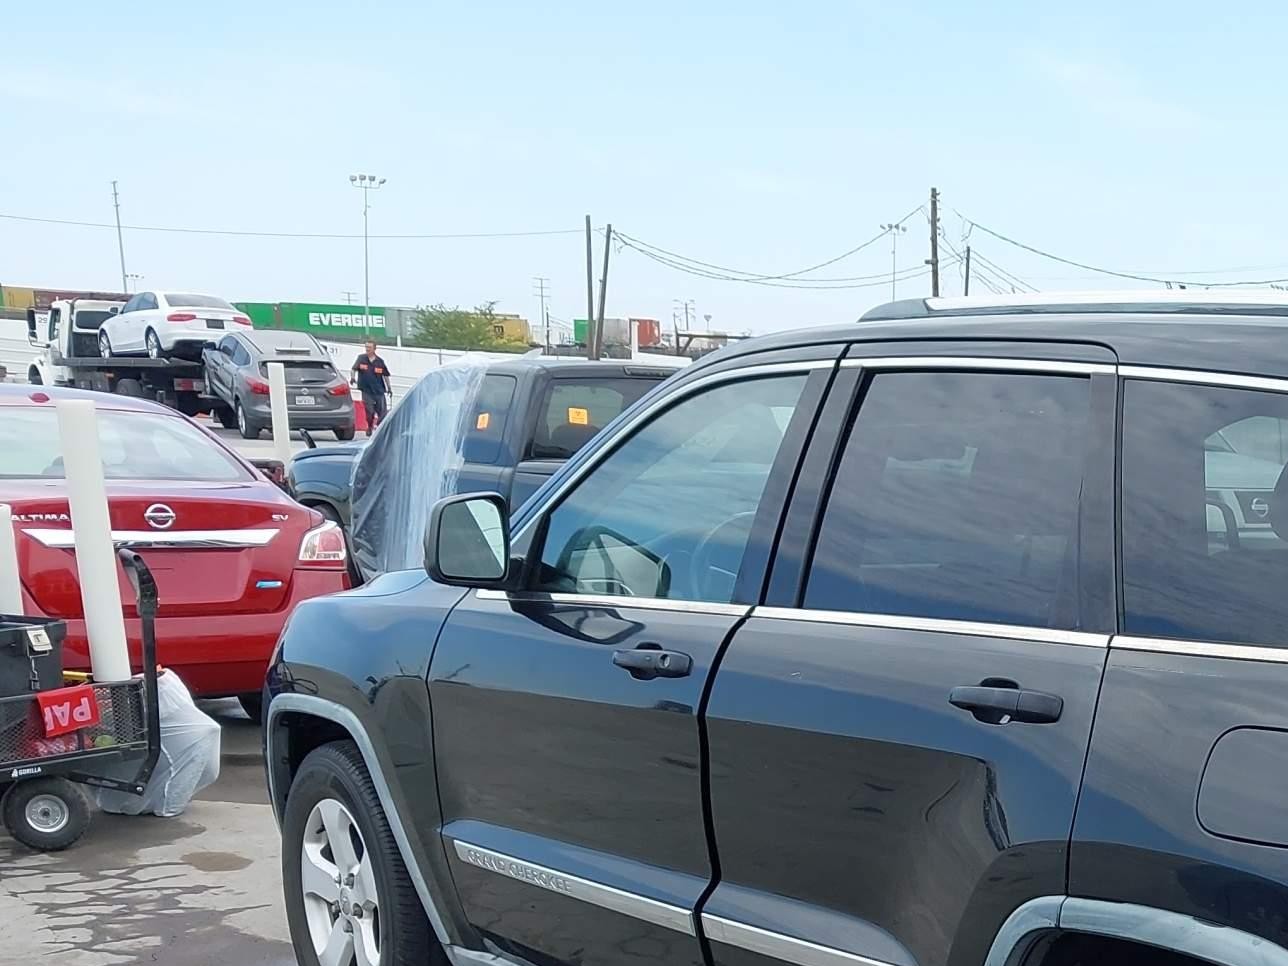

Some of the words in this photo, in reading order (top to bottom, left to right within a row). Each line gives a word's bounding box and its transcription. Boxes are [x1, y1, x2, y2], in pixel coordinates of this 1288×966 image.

[11, 513, 71, 522] ALTIMA
[271, 514, 289, 522] SV
[18, 766, 42, 776] GORILLA
[466, 849, 505, 871] GRAND
[508, 862, 574, 893] CHEROKEE
